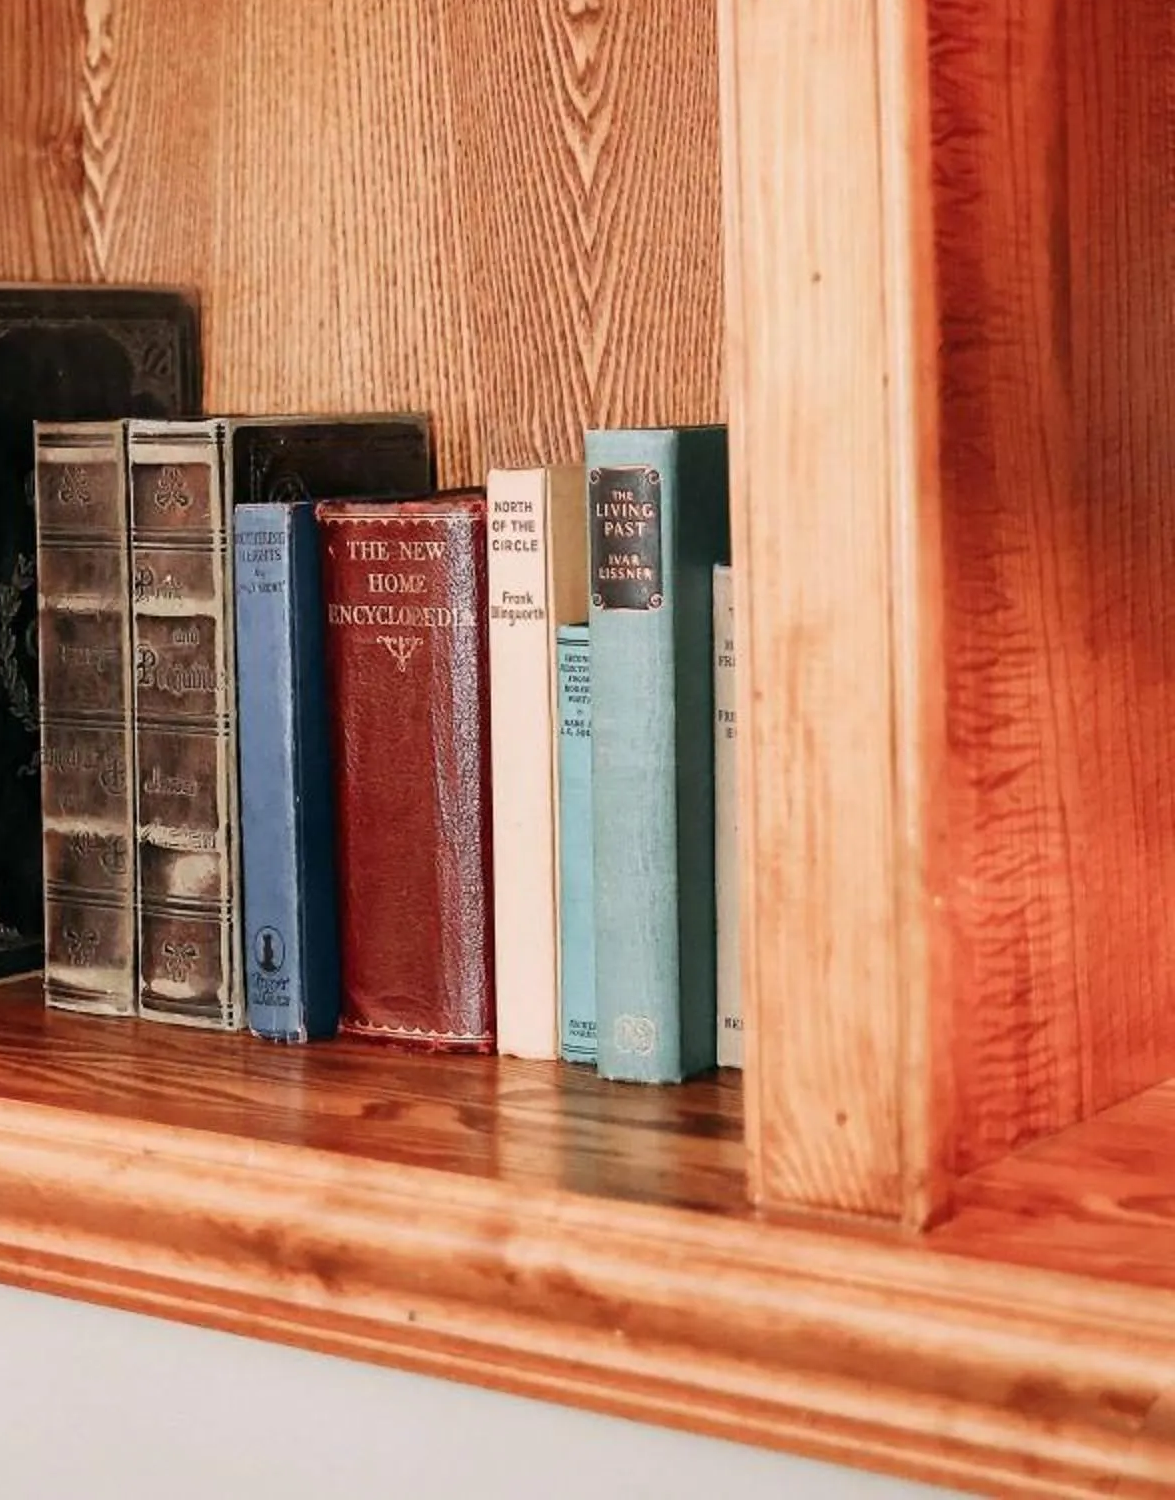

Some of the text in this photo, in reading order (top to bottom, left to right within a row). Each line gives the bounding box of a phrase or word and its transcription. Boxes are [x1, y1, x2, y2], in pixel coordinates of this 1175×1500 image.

[612, 490, 633, 501] THE
[494, 501, 533, 513] NORTH
[596, 503, 655, 518] LIVING
[492, 520, 536, 533] OF THE
[604, 521, 647, 538] PAST
[346, 541, 447, 561] THE NEW
[492, 539, 539, 552] CIRCLE
[608, 554, 641, 565] IVAR
[599, 567, 653, 581] LISSNER
[368, 573, 427, 593] HOME
[501, 591, 534, 605] Frank
